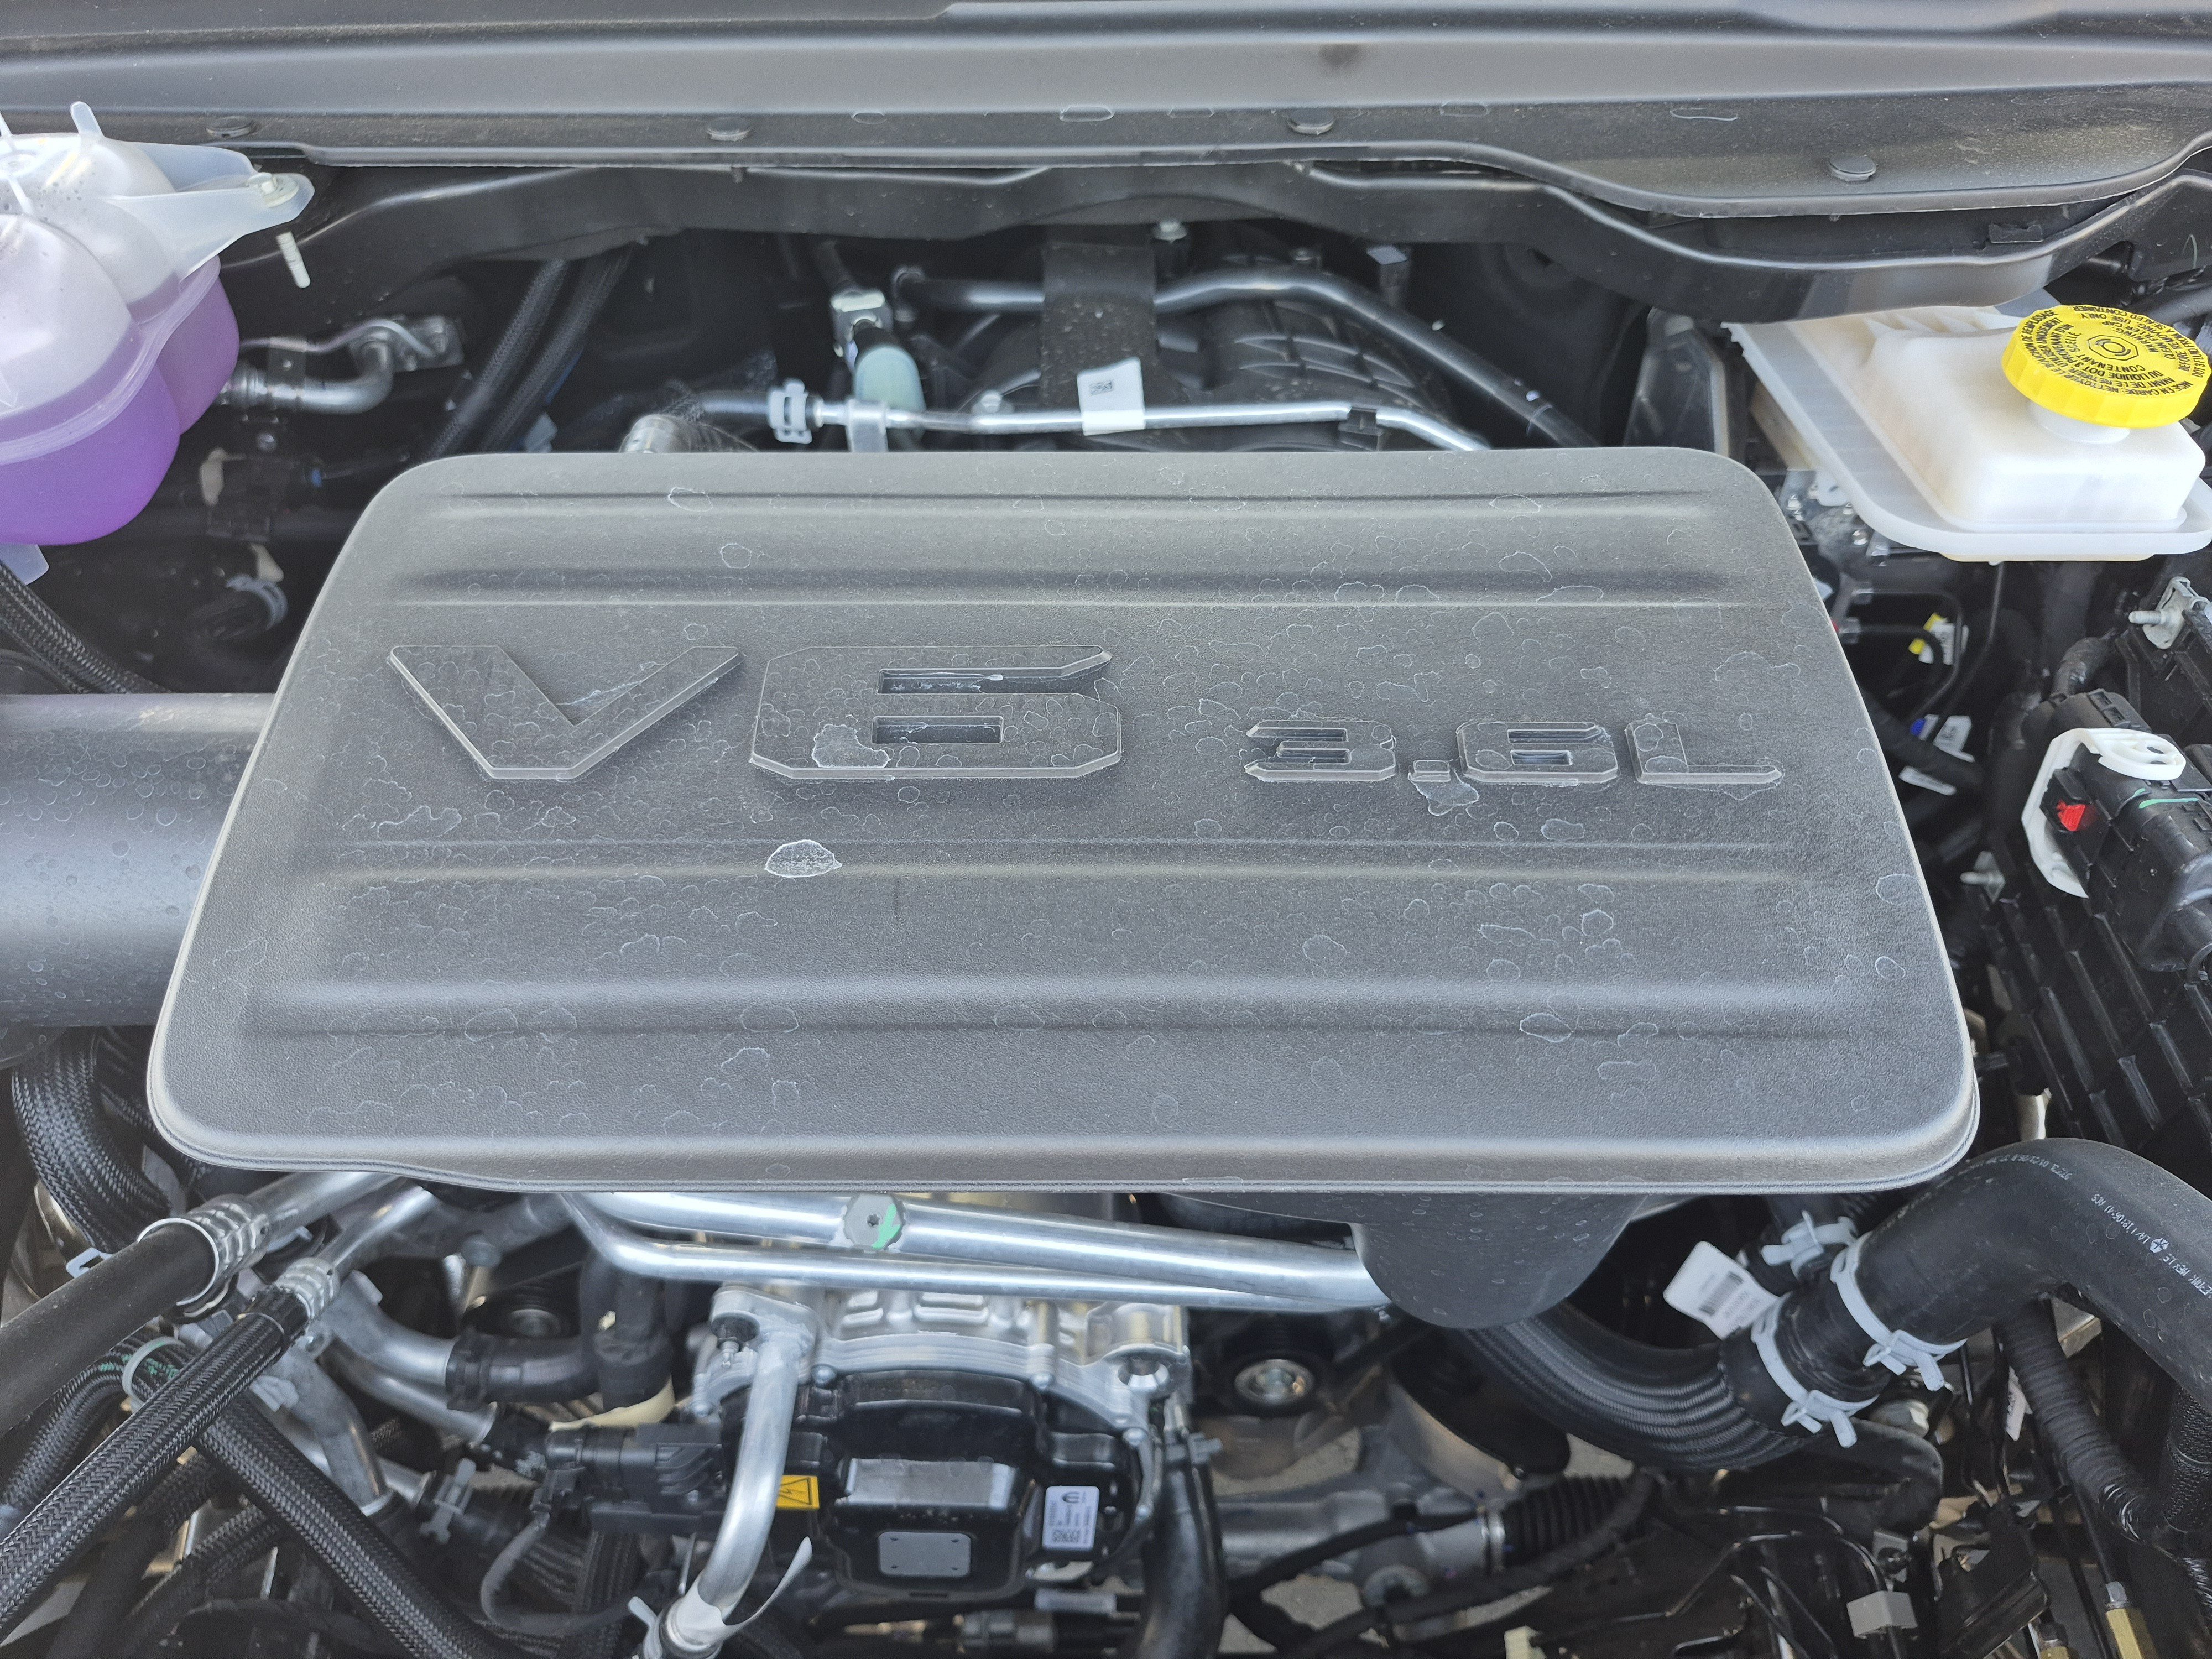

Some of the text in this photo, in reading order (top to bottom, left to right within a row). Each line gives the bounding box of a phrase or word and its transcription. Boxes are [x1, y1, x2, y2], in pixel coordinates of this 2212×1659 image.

[2111, 315, 2131, 324] USE
[2130, 314, 2166, 330] SEALED
[2111, 327, 2159, 352] WARNING:
[2125, 325, 2158, 341] FILLER
[2171, 333, 2194, 347] FROM
[2154, 342, 2176, 360] CLEAN
[2188, 348, 2205, 364] FLUID
[2076, 354, 2146, 372] CONTENANT
[2175, 351, 2190, 372] BEFORE
[2082, 366, 2105, 376] DOT
[2109, 372, 2151, 380] LIQUIDE
[2192, 367, 2205, 378] DOT
[2147, 377, 2176, 388] AVANT
[2171, 380, 2194, 392] MISE
[387, 644, 1783, 784] V6 3.6L
